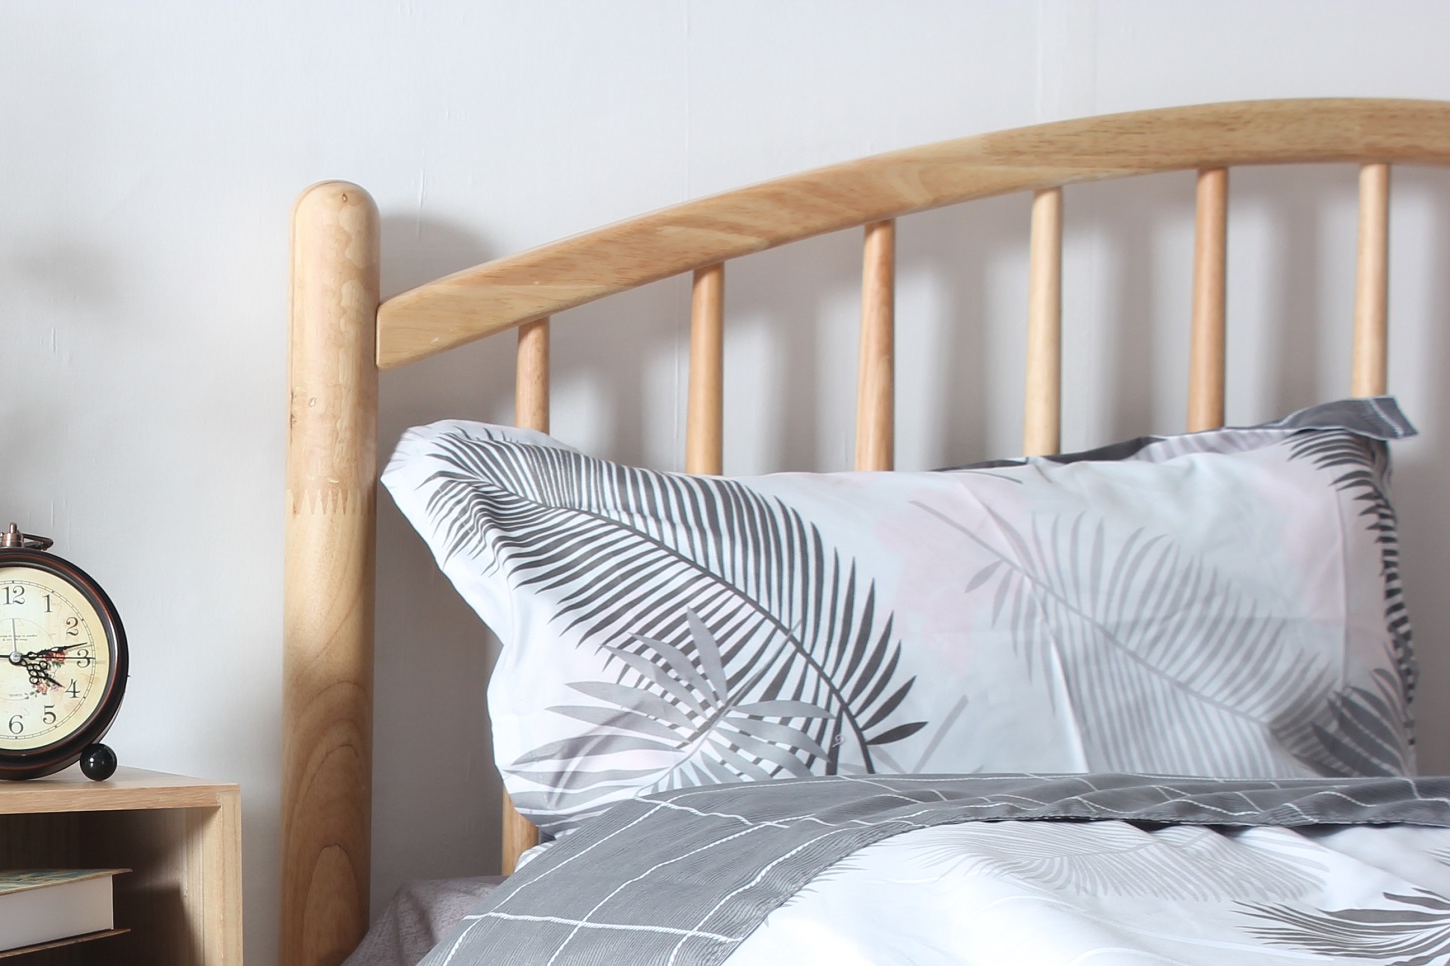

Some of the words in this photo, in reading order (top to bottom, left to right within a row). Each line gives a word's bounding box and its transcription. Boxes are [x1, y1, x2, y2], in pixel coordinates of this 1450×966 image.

[3, 585, 25, 605] 12
[43, 594, 54, 612] 1
[66, 617, 79, 636] 2
[77, 649, 91, 668] 3
[65, 679, 80, 698] 4
[43, 705, 56, 724] 5
[9, 715, 24, 734] 6
